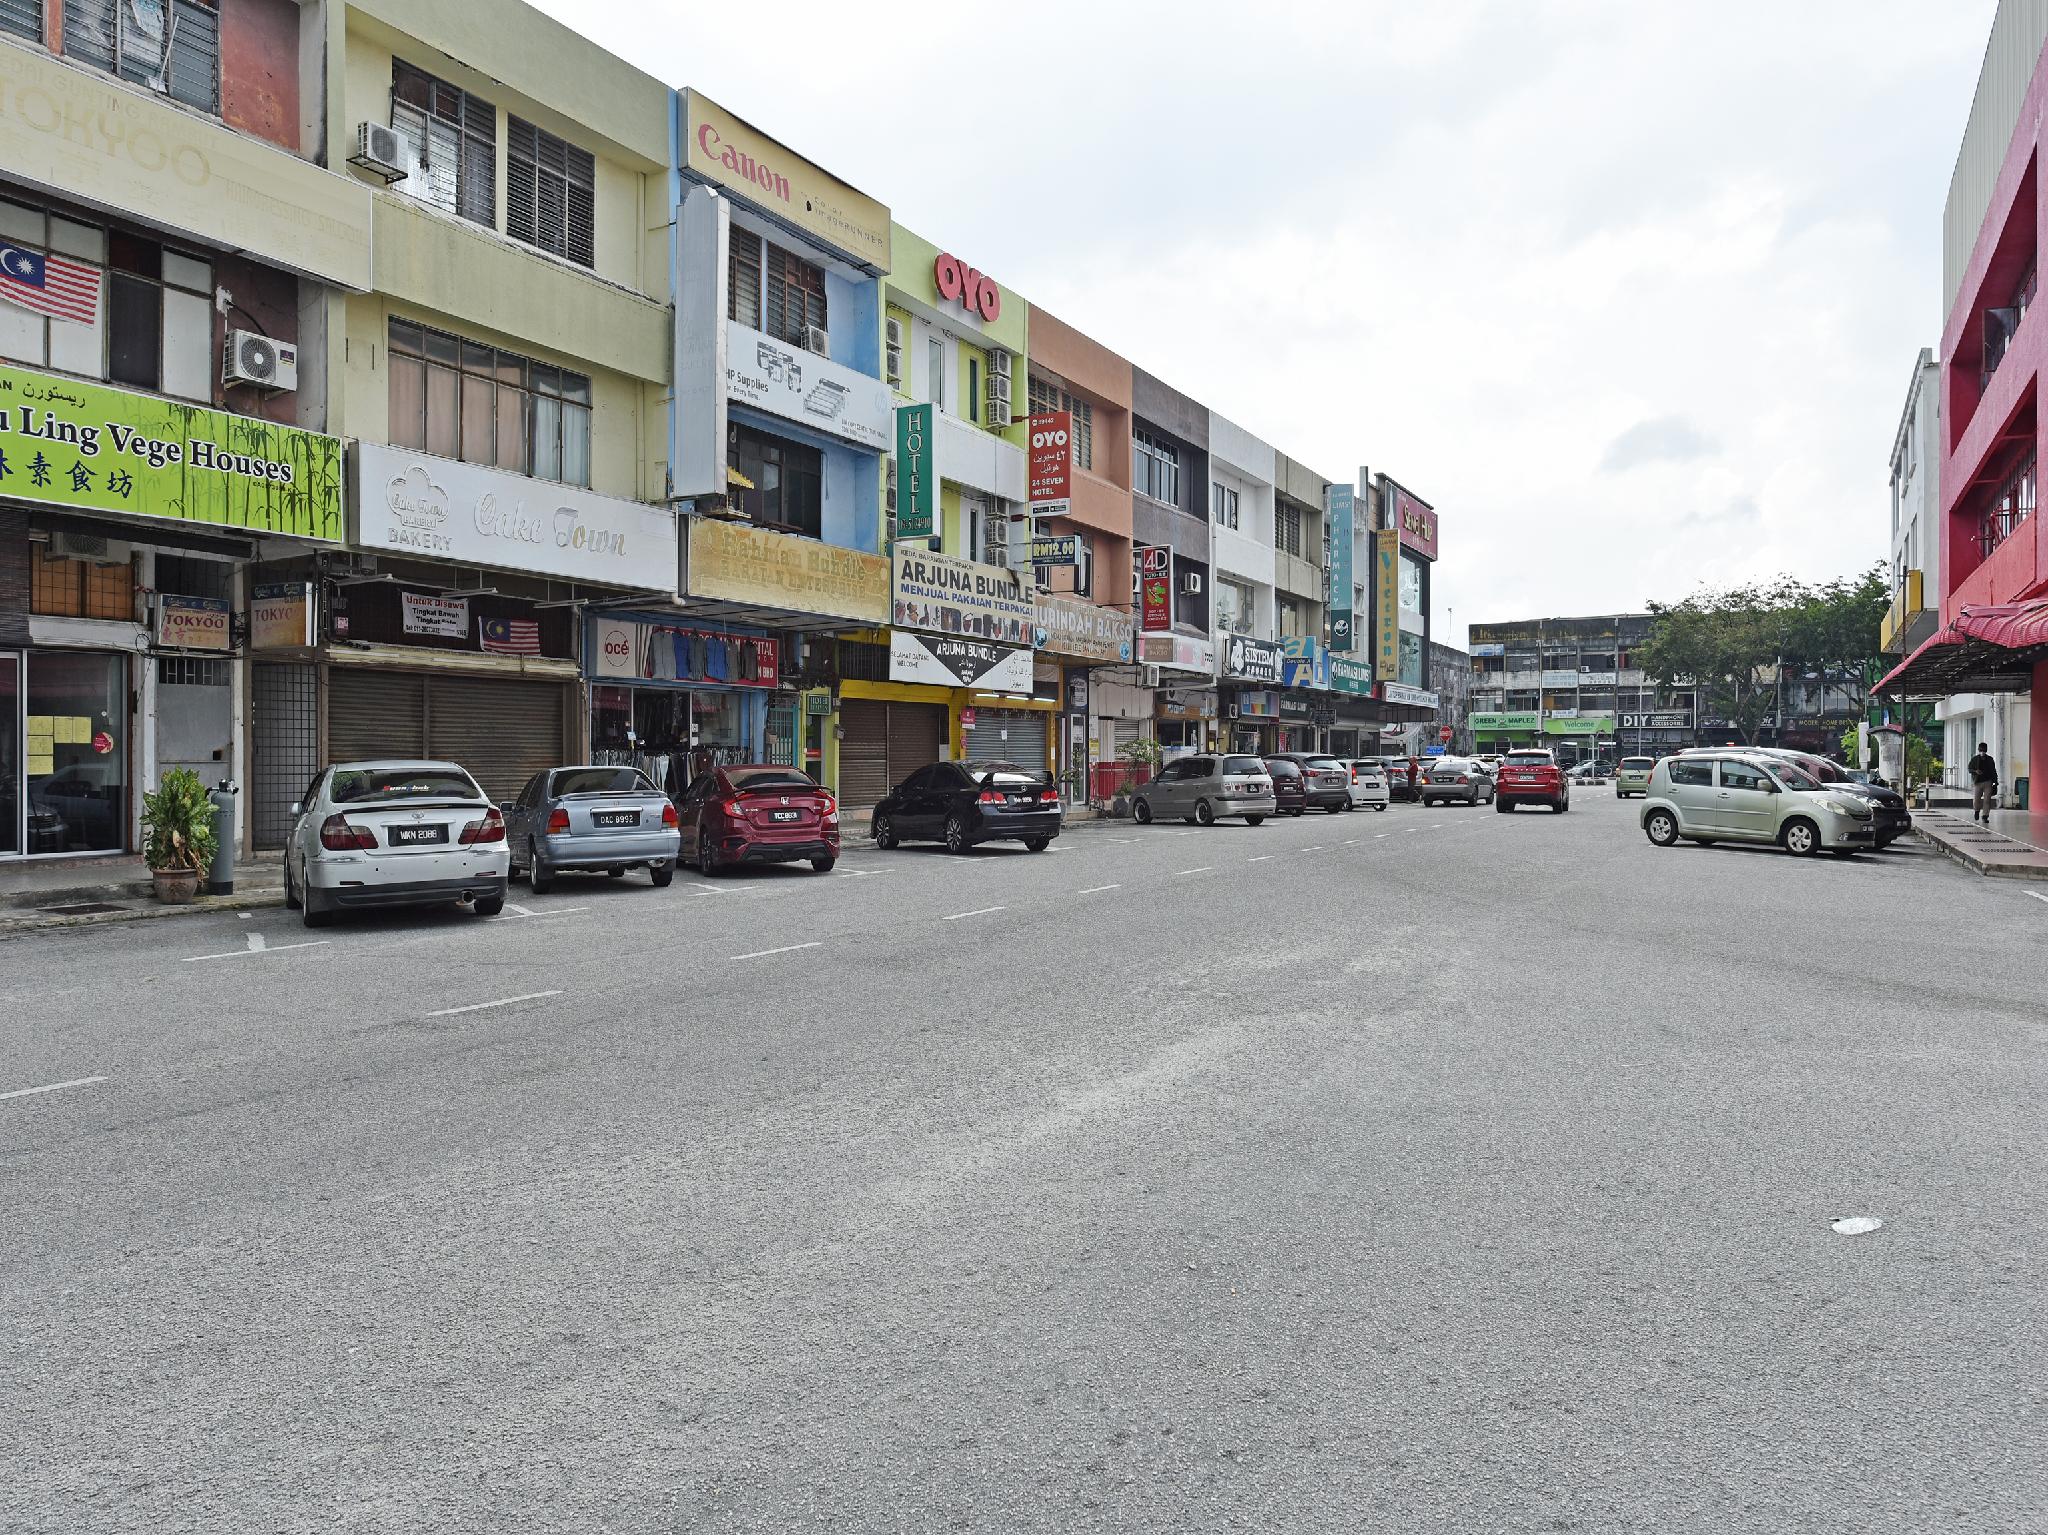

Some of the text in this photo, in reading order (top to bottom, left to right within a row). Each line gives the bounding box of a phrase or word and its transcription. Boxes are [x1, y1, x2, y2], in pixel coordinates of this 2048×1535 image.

[698, 123, 790, 203] Canon
[934, 252, 1001, 322] OYO
[737, 374, 769, 393] Supplies
[19, 405, 99, 456] Ling
[106, 423, 181, 468] Vege
[190, 440, 291, 483] Houses
[1032, 430, 1068, 448] OYO
[906, 411, 924, 515] HOTEL
[1042, 477, 1064, 486] SEVEN
[1032, 488, 1054, 497] HOTEL
[388, 527, 454, 552] BAKERY
[553, 506, 627, 557] Town
[1033, 542, 1075, 557] RM12.00
[1145, 549, 1168, 571] 4D
[1332, 514, 1341, 605] PHARMACY
[901, 560, 1034, 605] ARJUNA BUNDLE
[407, 596, 432, 606] Untuk
[900, 583, 1033, 617] MENJUAL PAKAIAN TERPAKAI
[165, 614, 224, 629] TOKYOO
[412, 607, 460, 618] Tingkat Bawah
[416, 616, 440, 625] Tingkat
[1097, 618, 1132, 641] BAKSO
[605, 639, 629, 656] océ
[936, 643, 966, 657] ARJUNA
[967, 645, 997, 663] BUNDLE
[896, 659, 919, 668] WELCOME
[1564, 719, 1595, 728] Welcome
[1623, 715, 1649, 727] DIY
[615, 815, 634, 823] 8992
[400, 830, 416, 840] WKN
